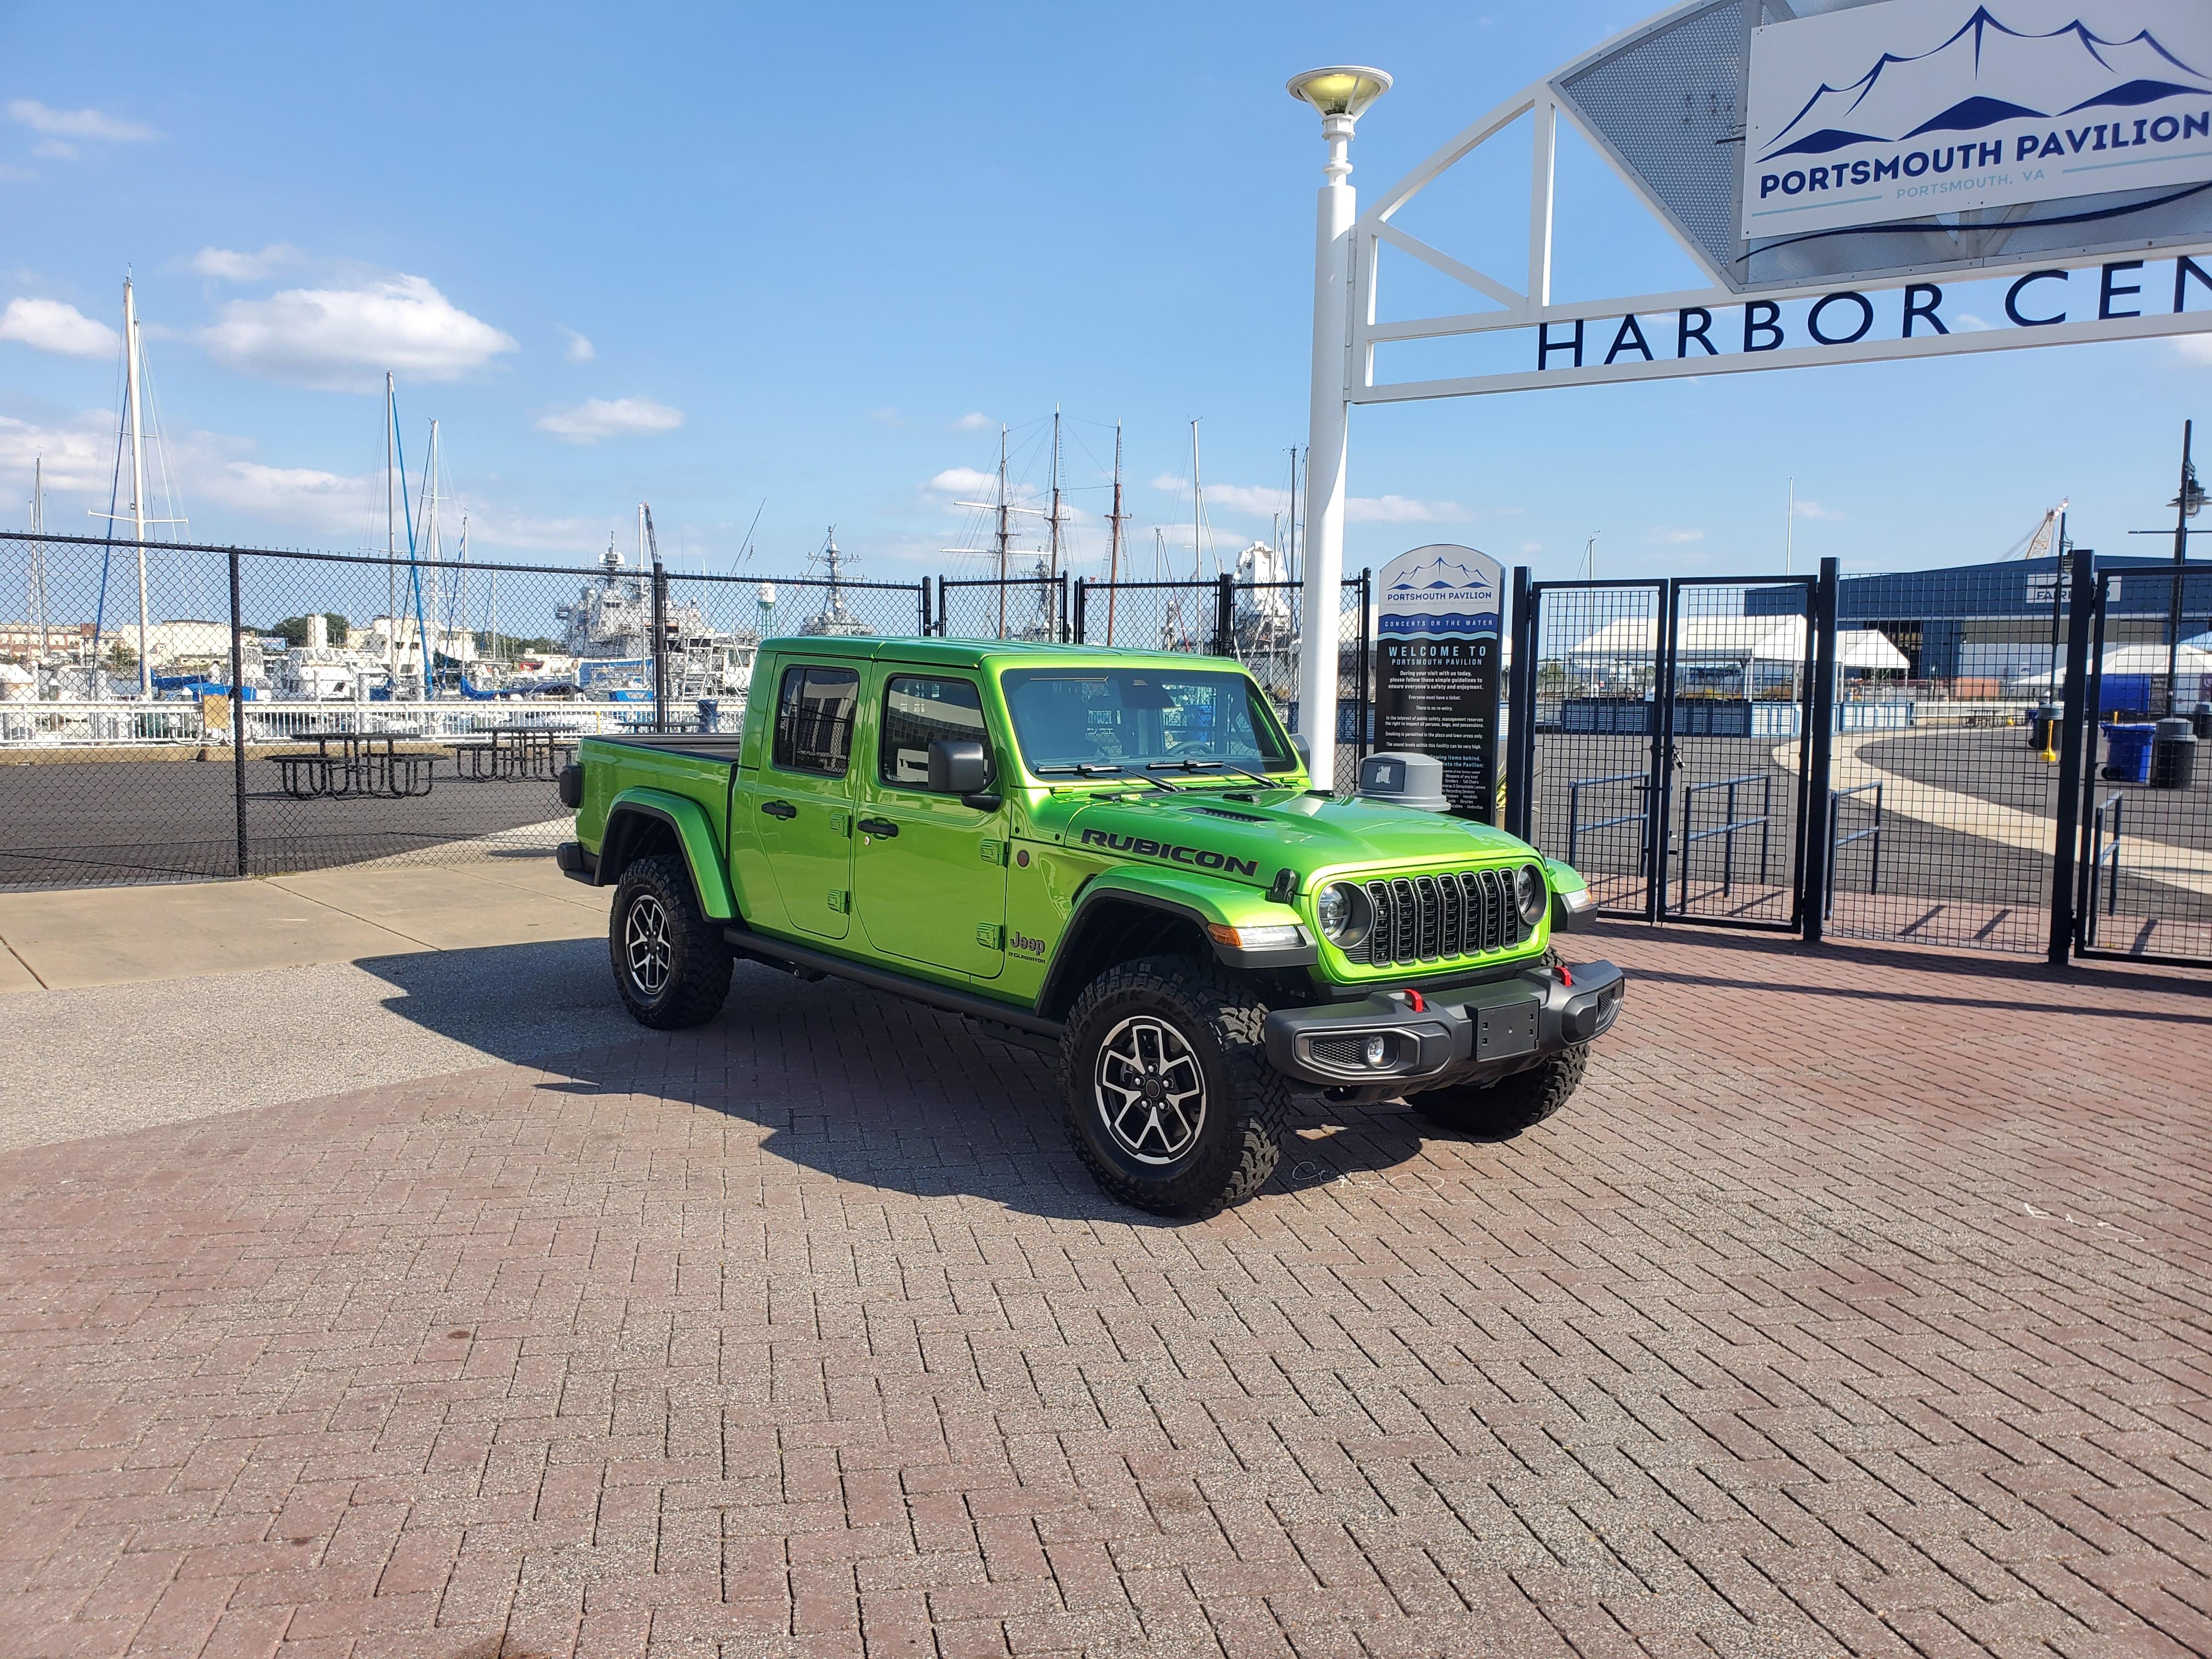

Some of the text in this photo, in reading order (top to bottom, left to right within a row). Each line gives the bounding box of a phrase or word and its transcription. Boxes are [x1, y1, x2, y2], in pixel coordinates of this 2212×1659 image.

[1760, 111, 2209, 199] PORTSMOUTH PAVILION
[1897, 170, 2045, 200] PORTSMOUTH, VA
[1538, 284, 1950, 370] HARBOR
[1387, 593, 1446, 601] PORTSMOUTH
[1389, 646, 1487, 657] WELCOME TO
[1081, 828, 1259, 877] RUBICON
[1010, 932, 1045, 956] Jeep
[1014, 953, 1046, 964] GLADIATOR
